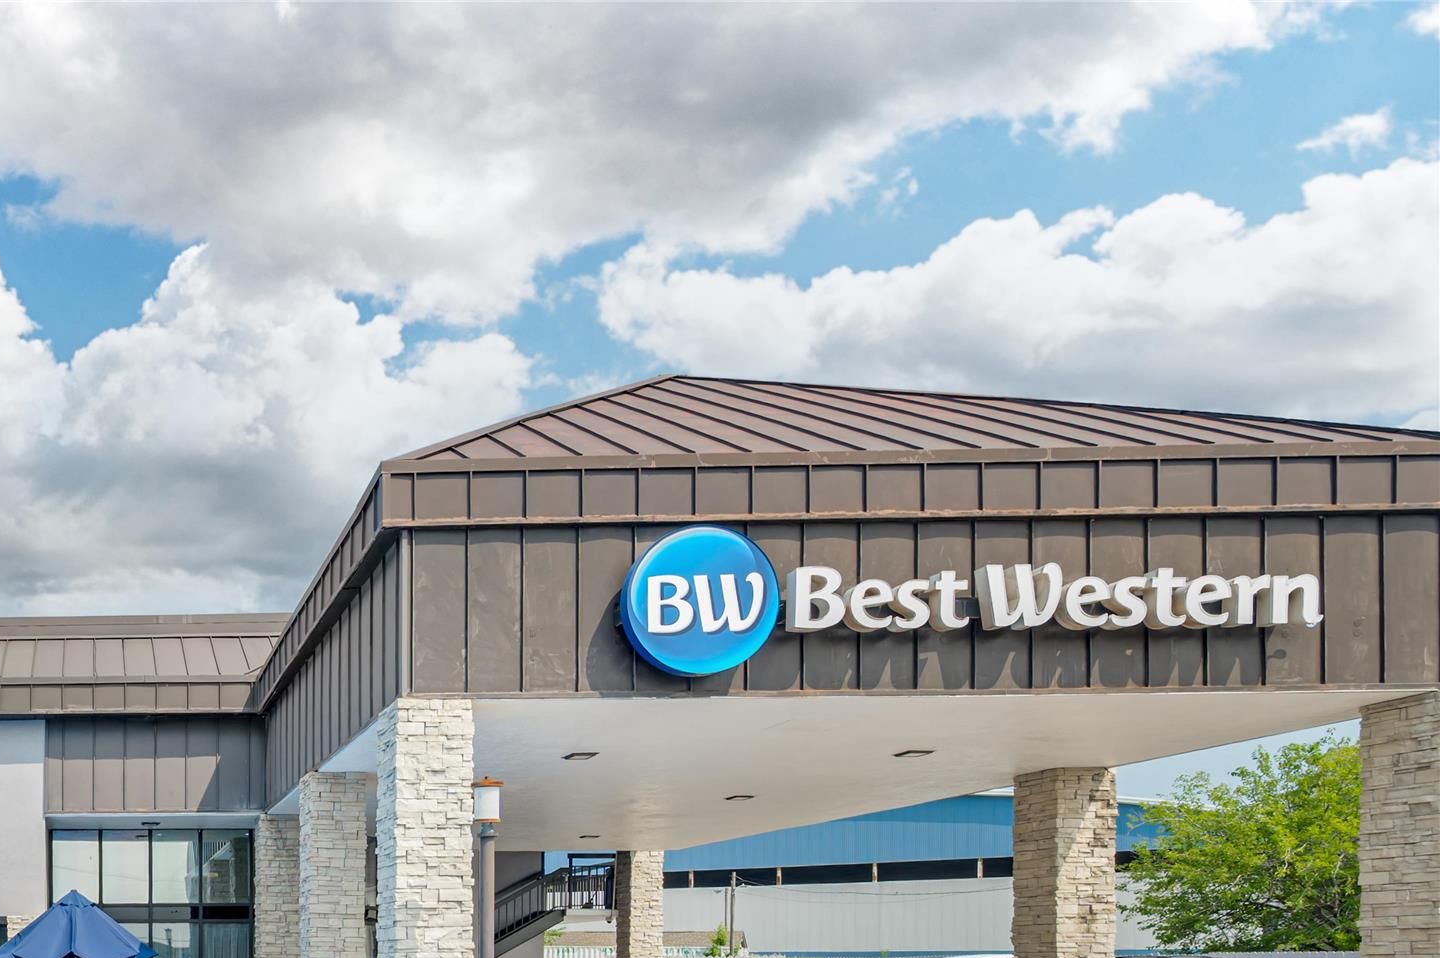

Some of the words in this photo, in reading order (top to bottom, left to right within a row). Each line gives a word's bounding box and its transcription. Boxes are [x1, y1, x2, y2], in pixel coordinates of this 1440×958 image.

[647, 572, 764, 634] BW
[788, 566, 969, 630] Best
[979, 563, 1323, 630] Western
